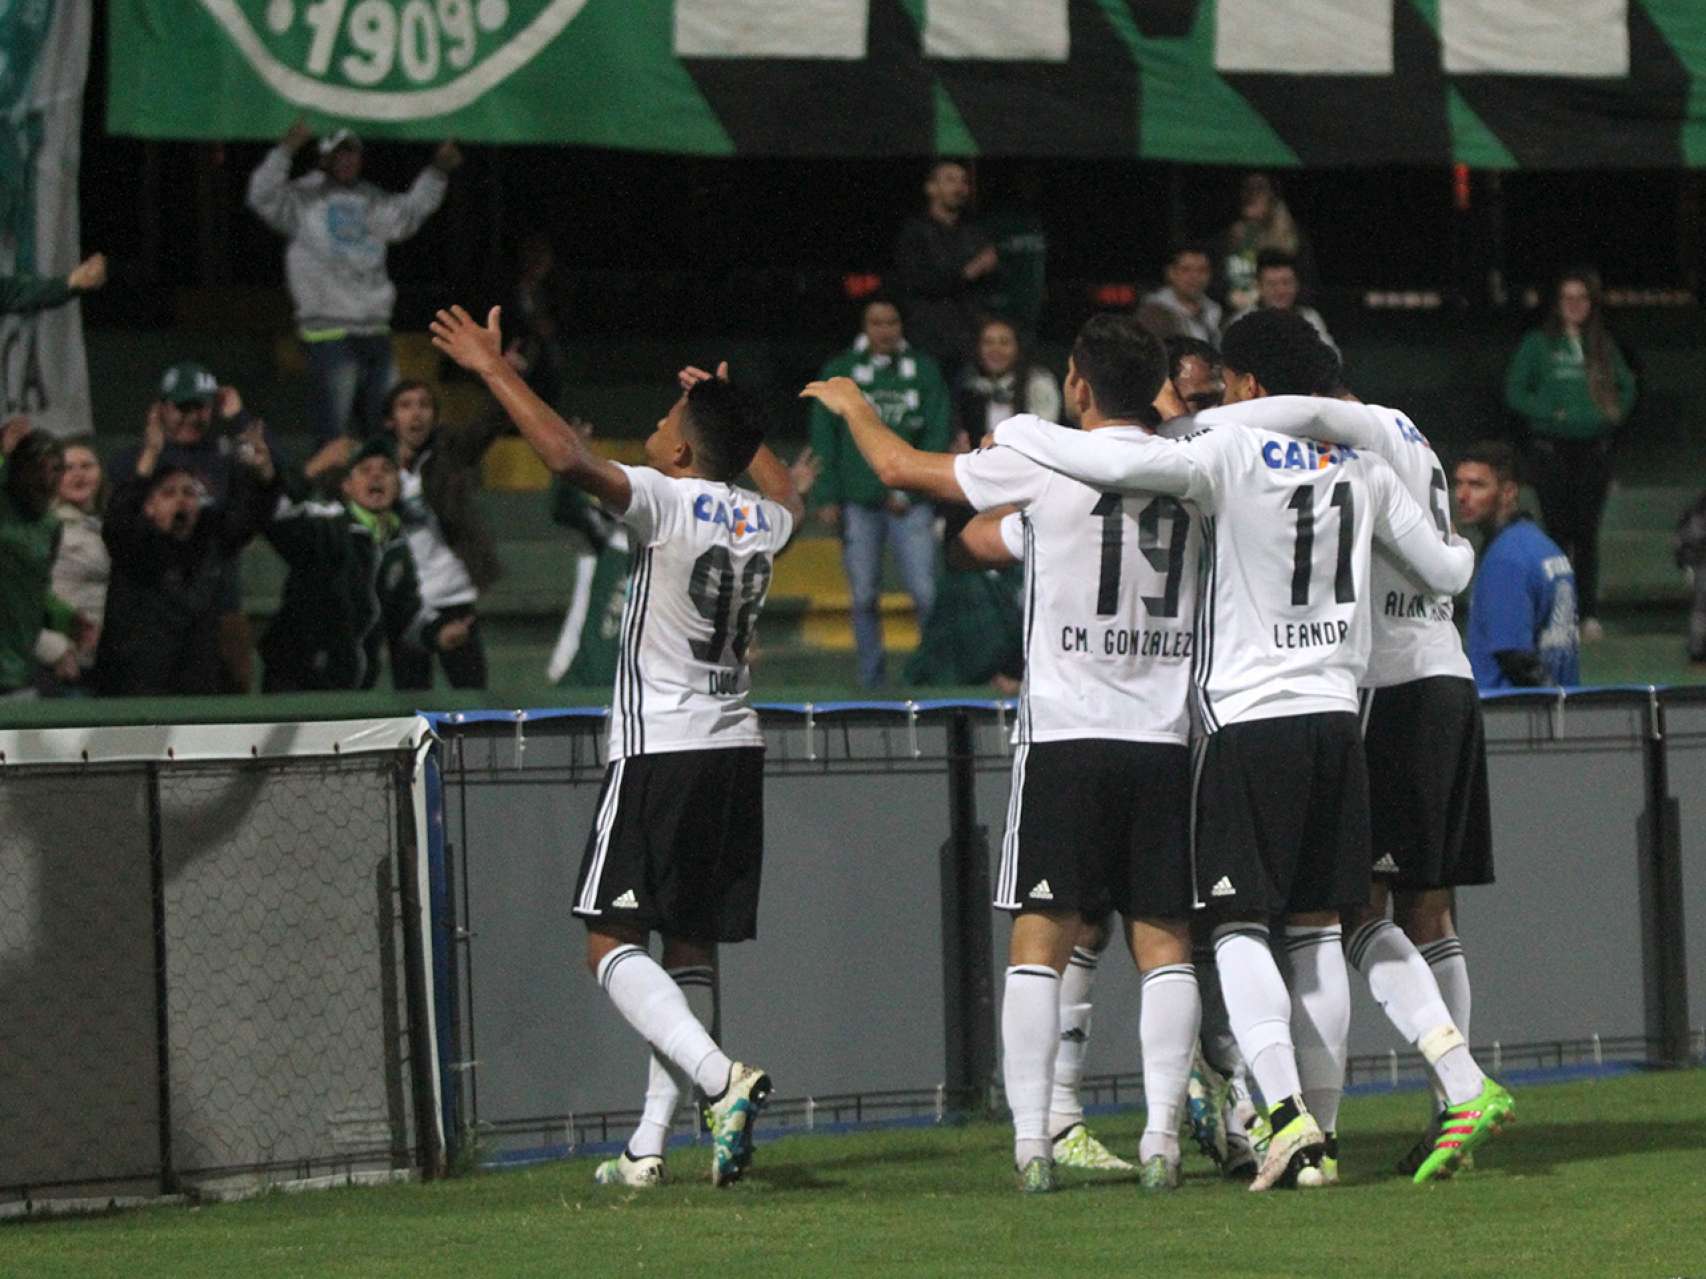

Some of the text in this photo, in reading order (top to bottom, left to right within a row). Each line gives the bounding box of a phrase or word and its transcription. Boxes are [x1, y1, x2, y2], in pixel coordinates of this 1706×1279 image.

[306, 0, 477, 85] 1909
[1090, 492, 1191, 618] 19
[1287, 481, 1357, 606] 11
[1104, 628, 1193, 657] GONZALEZ
